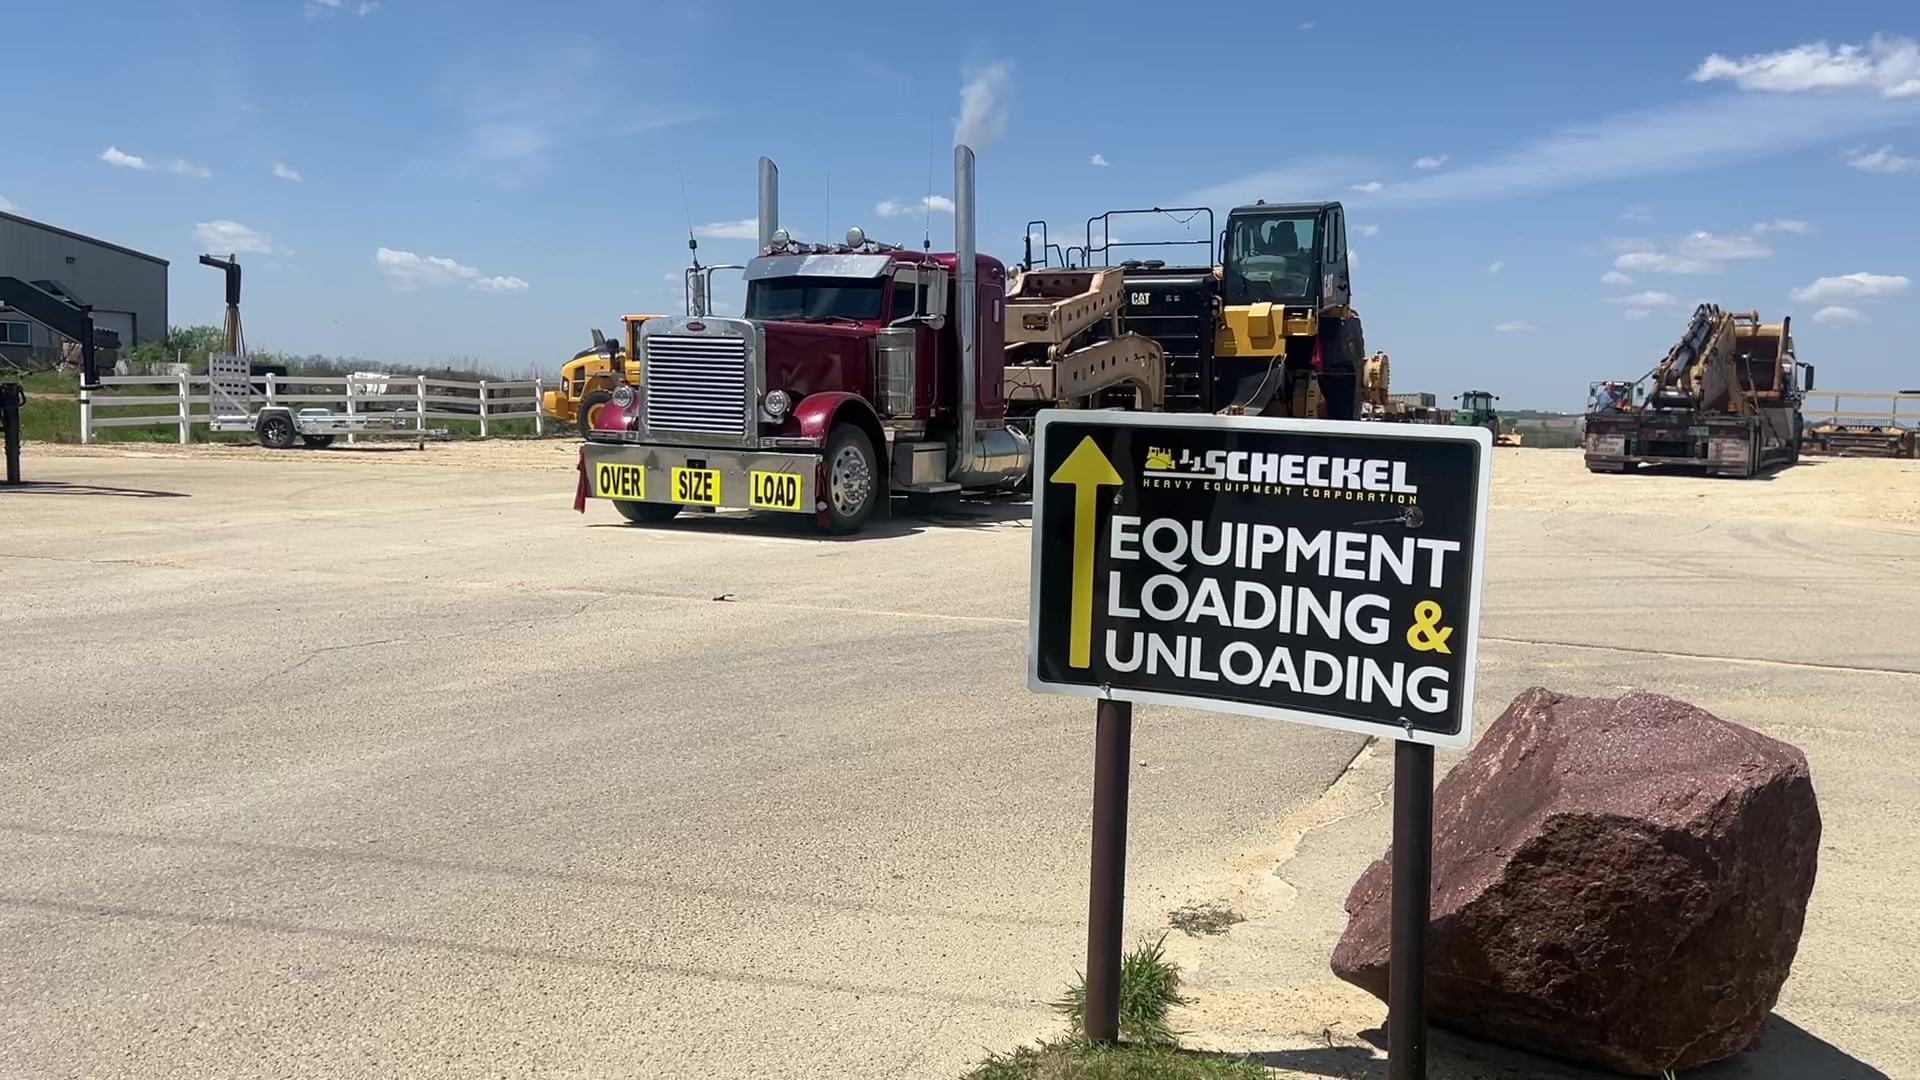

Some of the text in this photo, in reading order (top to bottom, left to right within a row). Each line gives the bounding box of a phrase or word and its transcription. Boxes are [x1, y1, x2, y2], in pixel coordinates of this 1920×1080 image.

[1131, 291, 1151, 306] CAT
[600, 465, 797, 507] OVER SIZE LOAD
[1143, 478, 1418, 505] HEAVY EQUIPMENT CORPORATION
[1204, 449, 1418, 494] SCHECKEL
[1110, 514, 1461, 588] EQUIPMENT
[1107, 570, 1454, 655] LOADING &
[1105, 629, 1450, 713] UNLOADING
